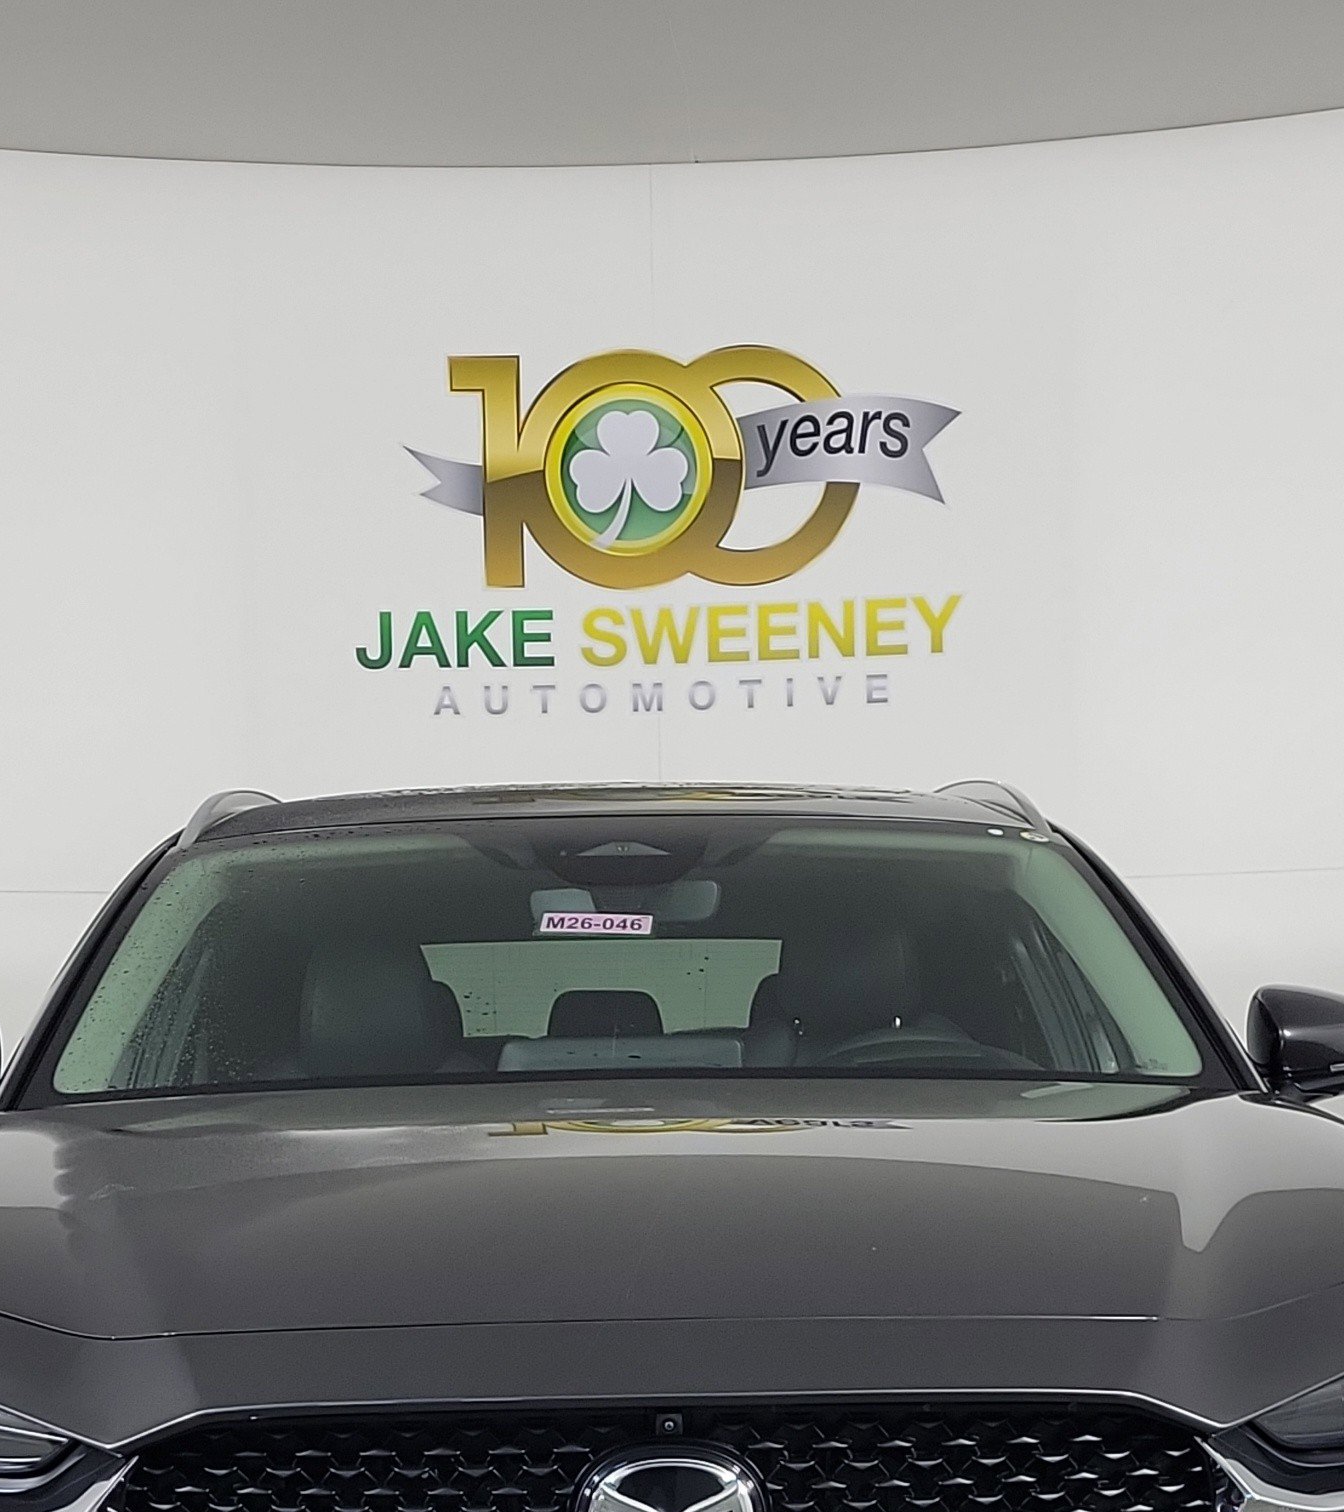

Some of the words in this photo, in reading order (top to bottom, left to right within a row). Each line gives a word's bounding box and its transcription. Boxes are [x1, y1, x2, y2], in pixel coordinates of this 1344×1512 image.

[447, 343, 860, 590] 100
[755, 408, 912, 477] years
[355, 609, 556, 671] JAKE
[579, 594, 963, 668] SWEENEY
[433, 673, 890, 716] AUTOMOTIVE
[546, 916, 643, 931] M26-046
